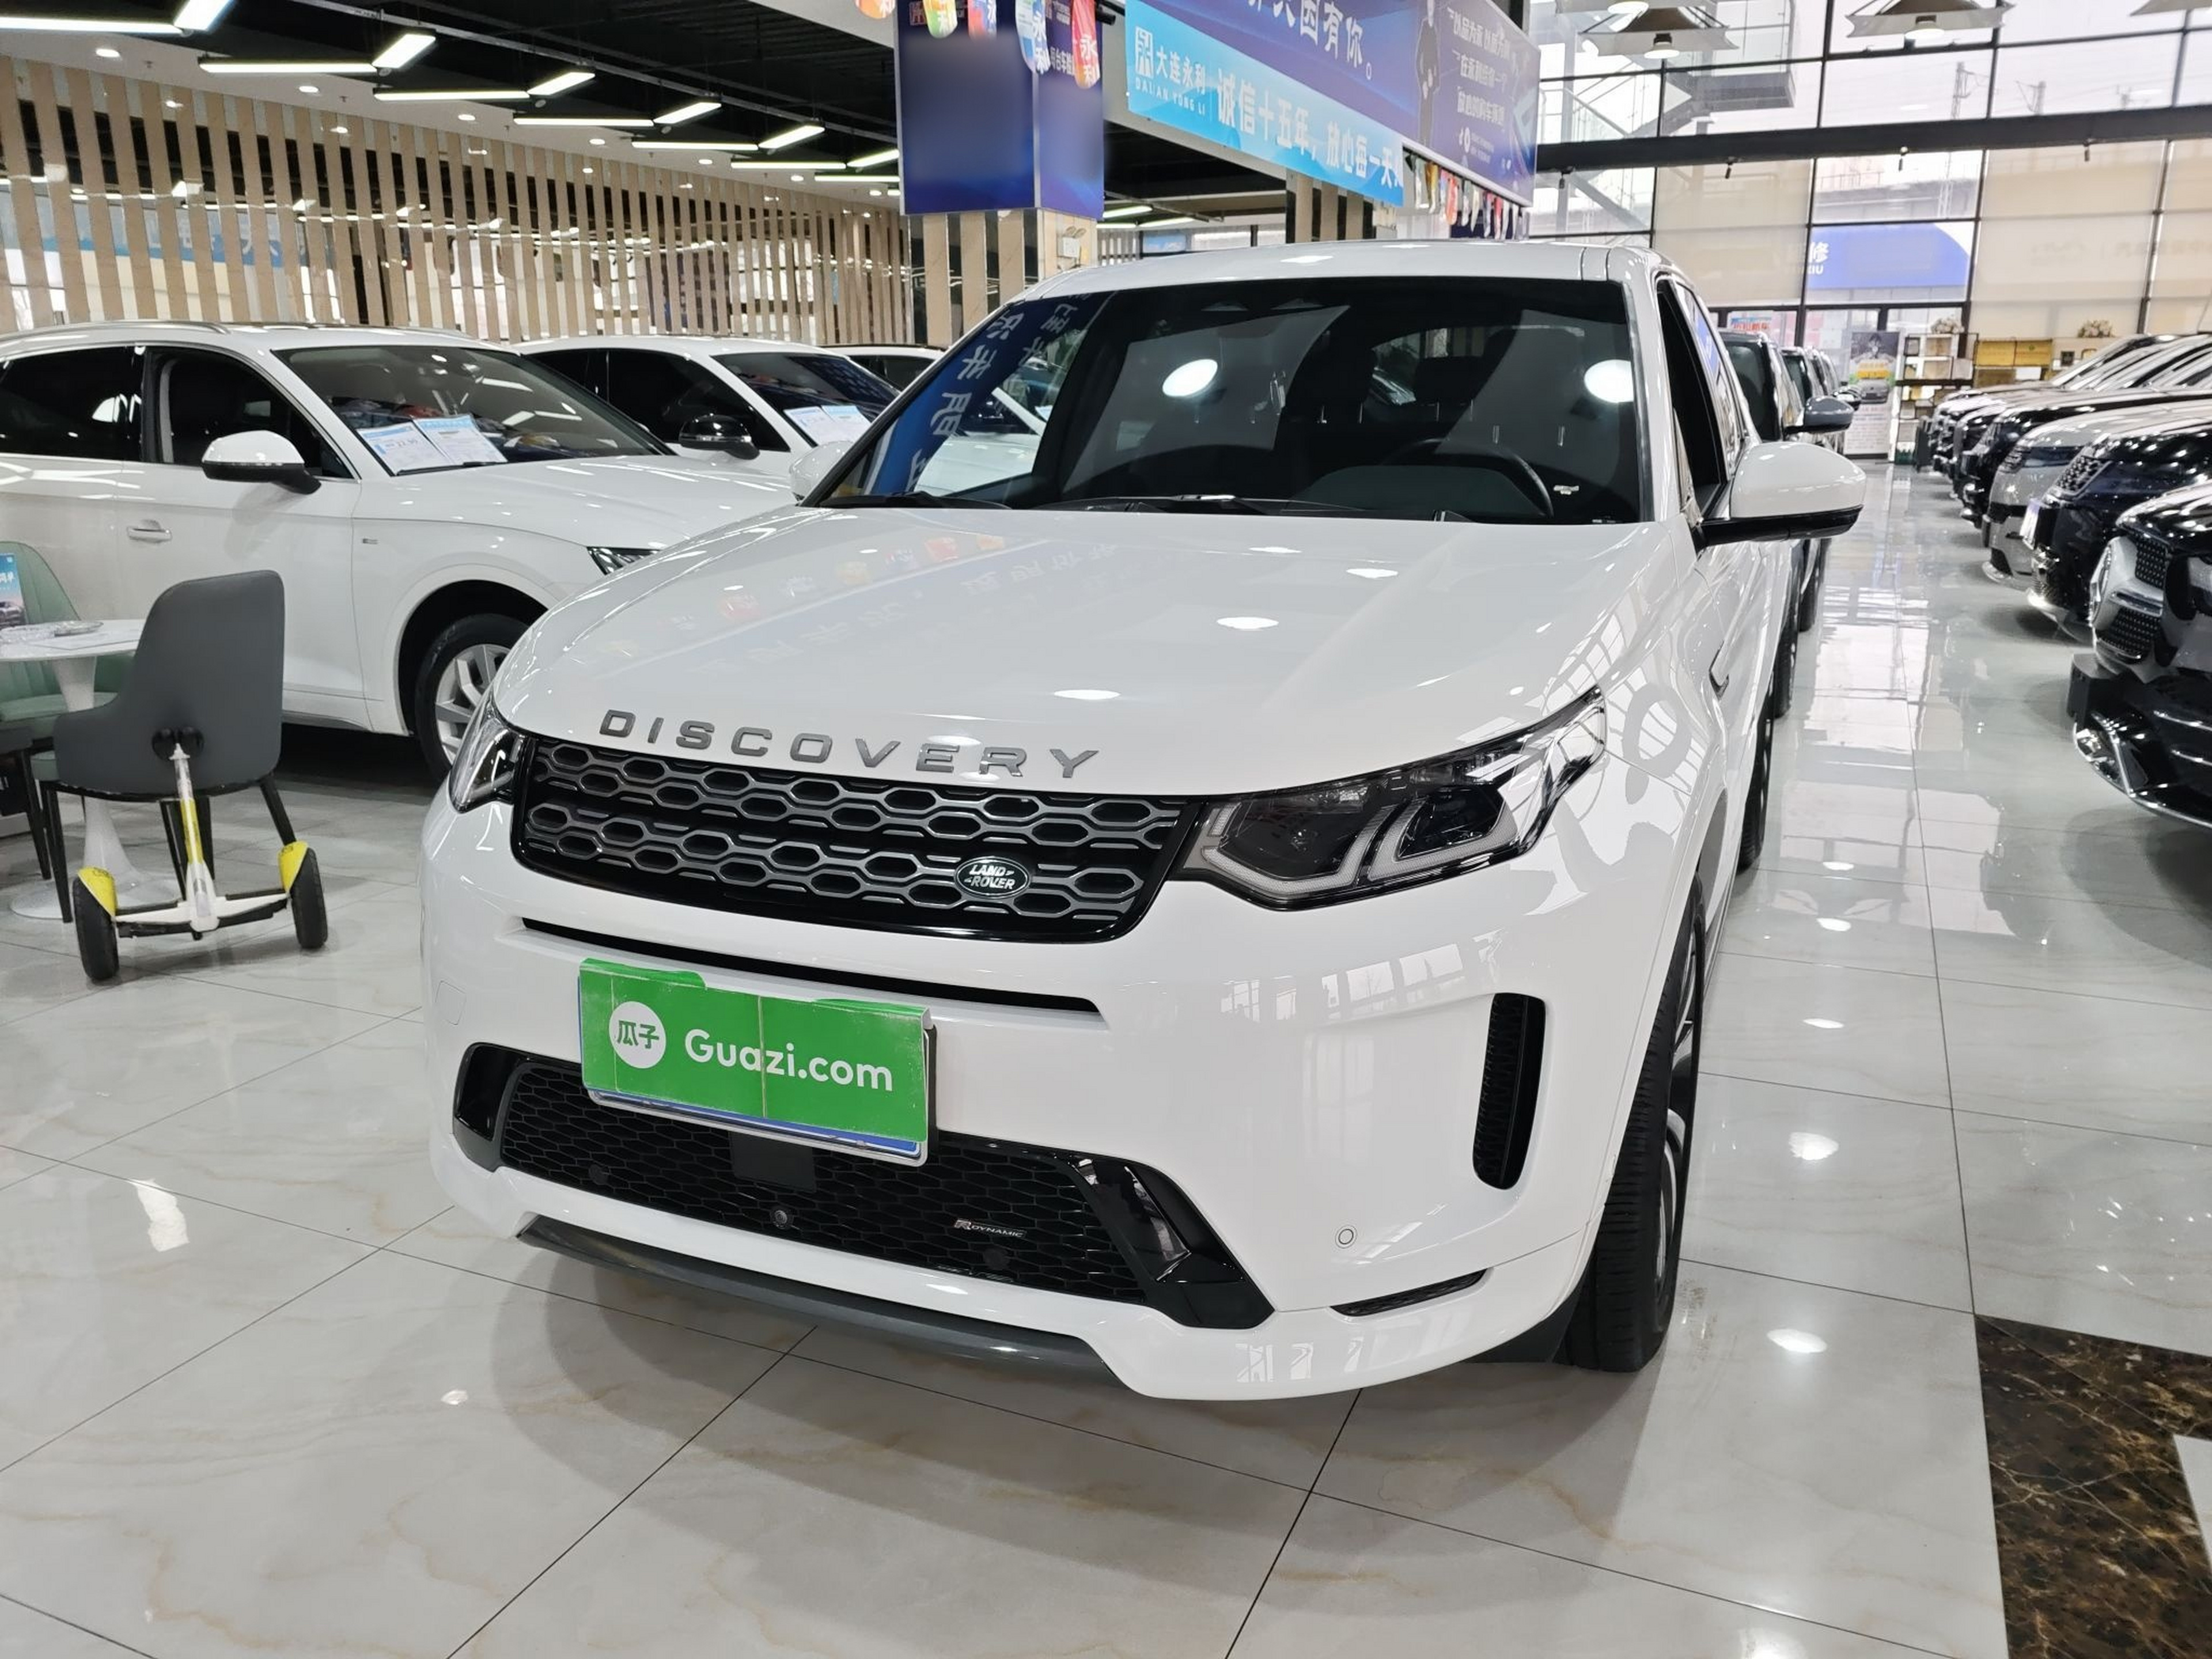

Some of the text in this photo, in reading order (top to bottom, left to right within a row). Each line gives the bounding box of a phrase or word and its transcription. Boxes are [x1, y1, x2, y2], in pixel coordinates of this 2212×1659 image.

[1080, 33, 1099, 88] 永利
[1156, 45, 1206, 95] 大连永利
[1135, 77, 1169, 101] DALIAN
[1172, 92, 1195, 112] YONG
[1809, 241, 1829, 263] 修
[599, 709, 1100, 778] DISCOVERY
[969, 864, 1006, 876] LAND
[970, 875, 1016, 889] ROVER
[616, 1019, 660, 1050] 瓜子
[684, 1028, 893, 1092] Guazi.com
